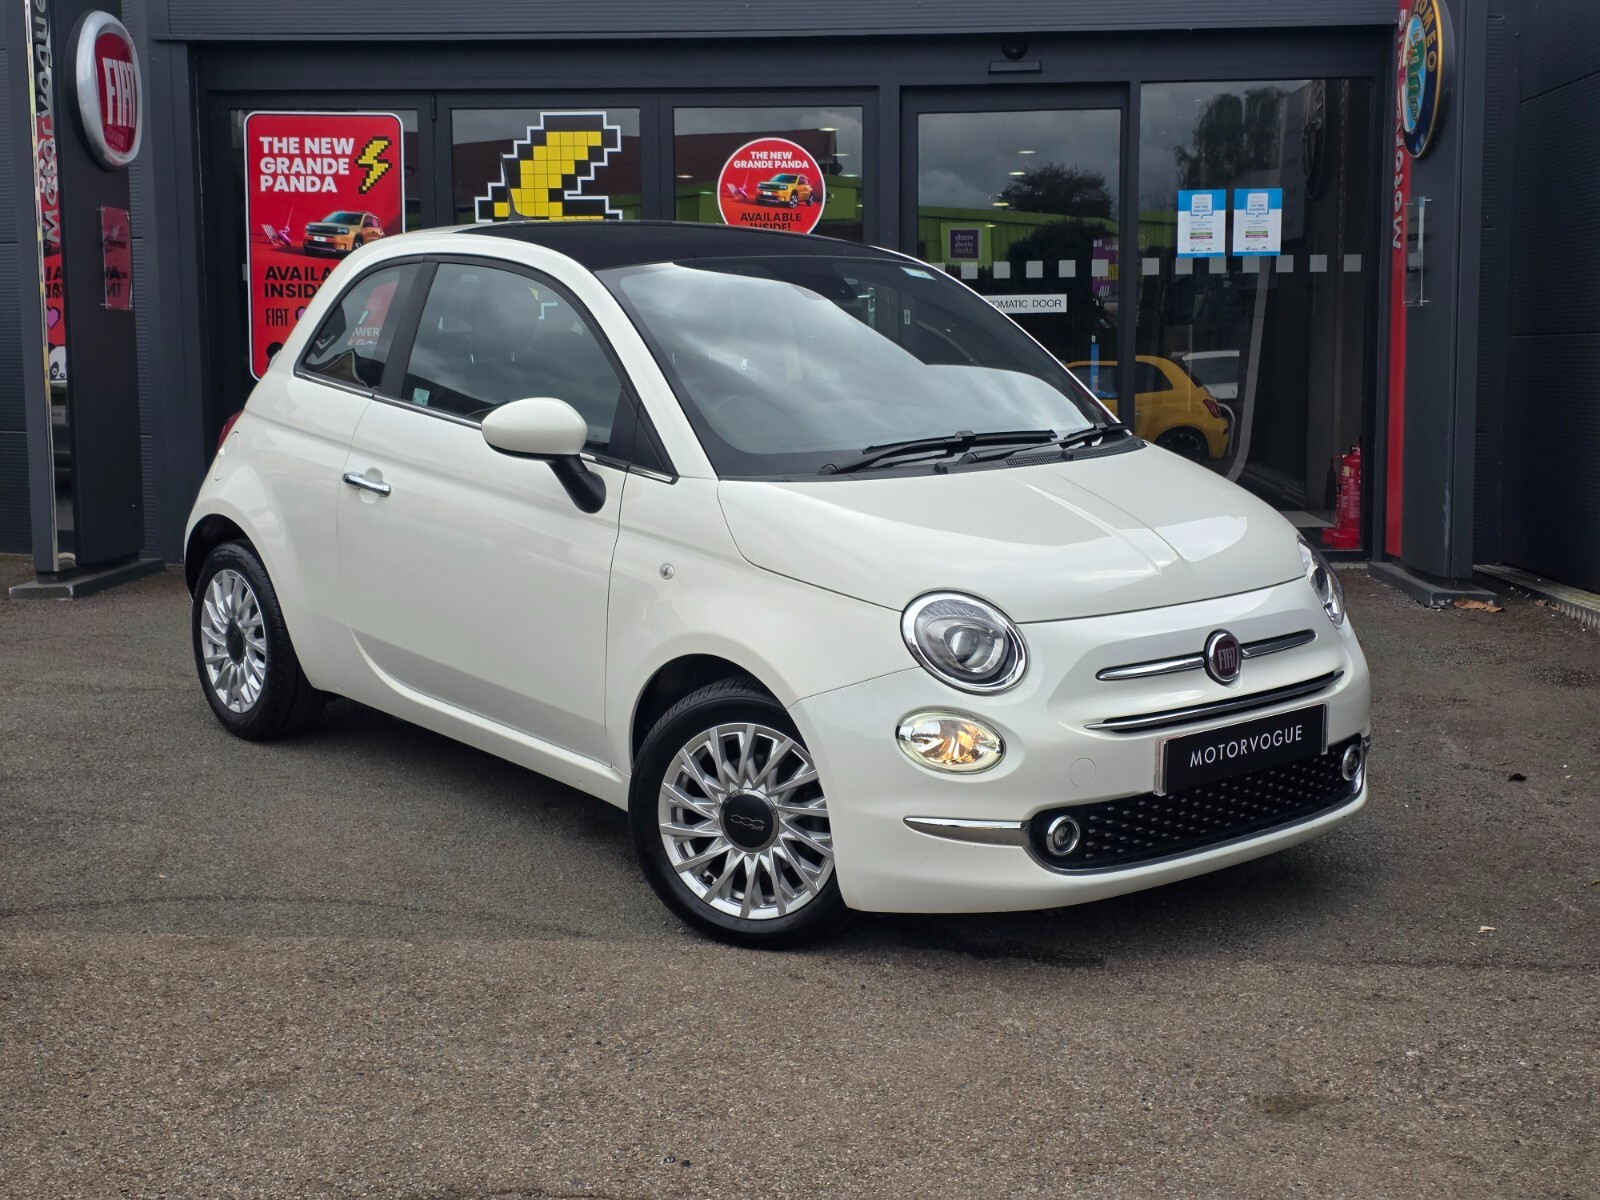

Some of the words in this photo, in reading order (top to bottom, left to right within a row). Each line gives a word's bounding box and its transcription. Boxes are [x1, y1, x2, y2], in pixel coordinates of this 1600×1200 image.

[102, 57, 138, 129] FIAT
[259, 137, 300, 154] THE
[304, 138, 355, 155] NEW
[733, 160, 774, 169] GRANDE
[775, 160, 810, 169] PANDA
[750, 151, 768, 160] THE
[770, 151, 793, 160] NEW
[260, 157, 350, 175] GRANDE
[260, 175, 338, 193] PANDA
[740, 212, 802, 222] AVAILABLE
[264, 266, 332, 281] AVAILA
[264, 283, 321, 298] INSID
[988, 300, 1028, 309] OMATIC
[1032, 299, 1062, 308] DOOR
[265, 308, 290, 327] FIAT
[1217, 646, 1237, 670] FIAT
[1189, 724, 1303, 768] MOTORVOGUE
